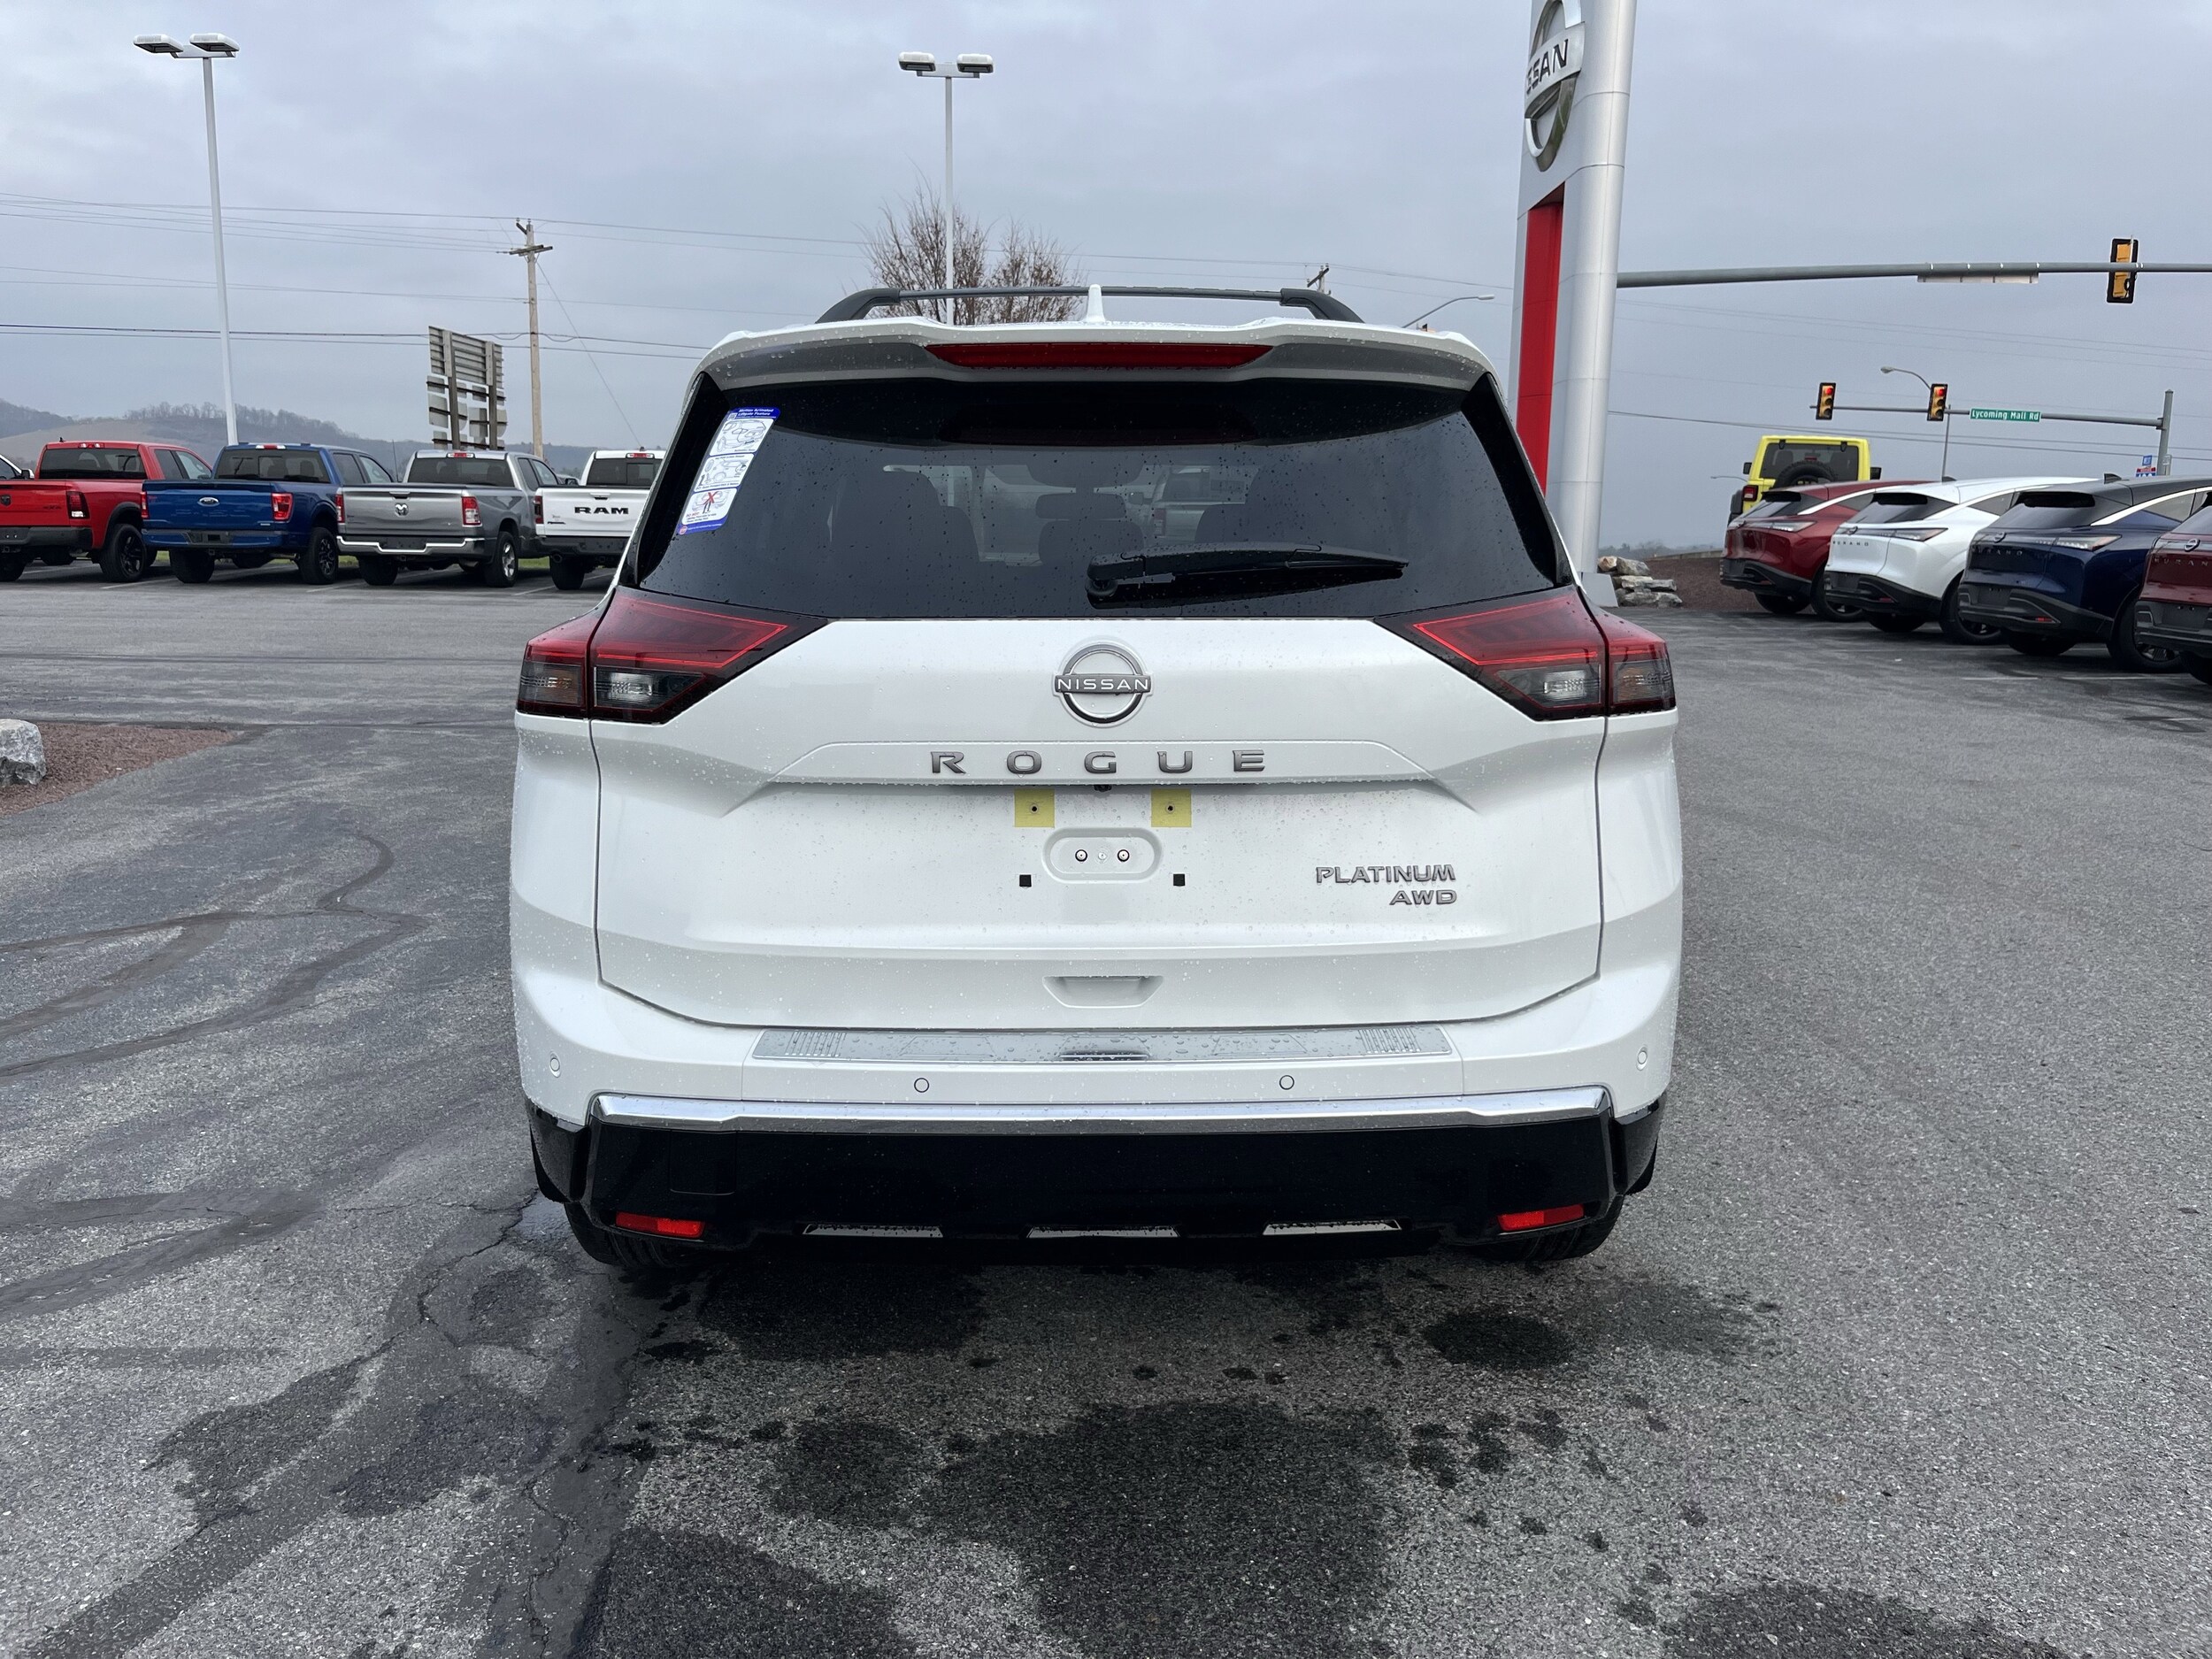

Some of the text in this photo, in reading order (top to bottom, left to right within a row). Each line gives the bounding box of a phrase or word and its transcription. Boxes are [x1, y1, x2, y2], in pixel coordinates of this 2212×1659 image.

[1526, 38, 1569, 96] SSAN
[1971, 409, 2039, 421] Lycoming Mall Rd
[574, 506, 629, 515] RAM
[1057, 678, 1148, 690] NISSAN
[930, 749, 1266, 775] ROGUE
[1316, 864, 1456, 883] PLATINUM
[1389, 889, 1457, 905] AWD
